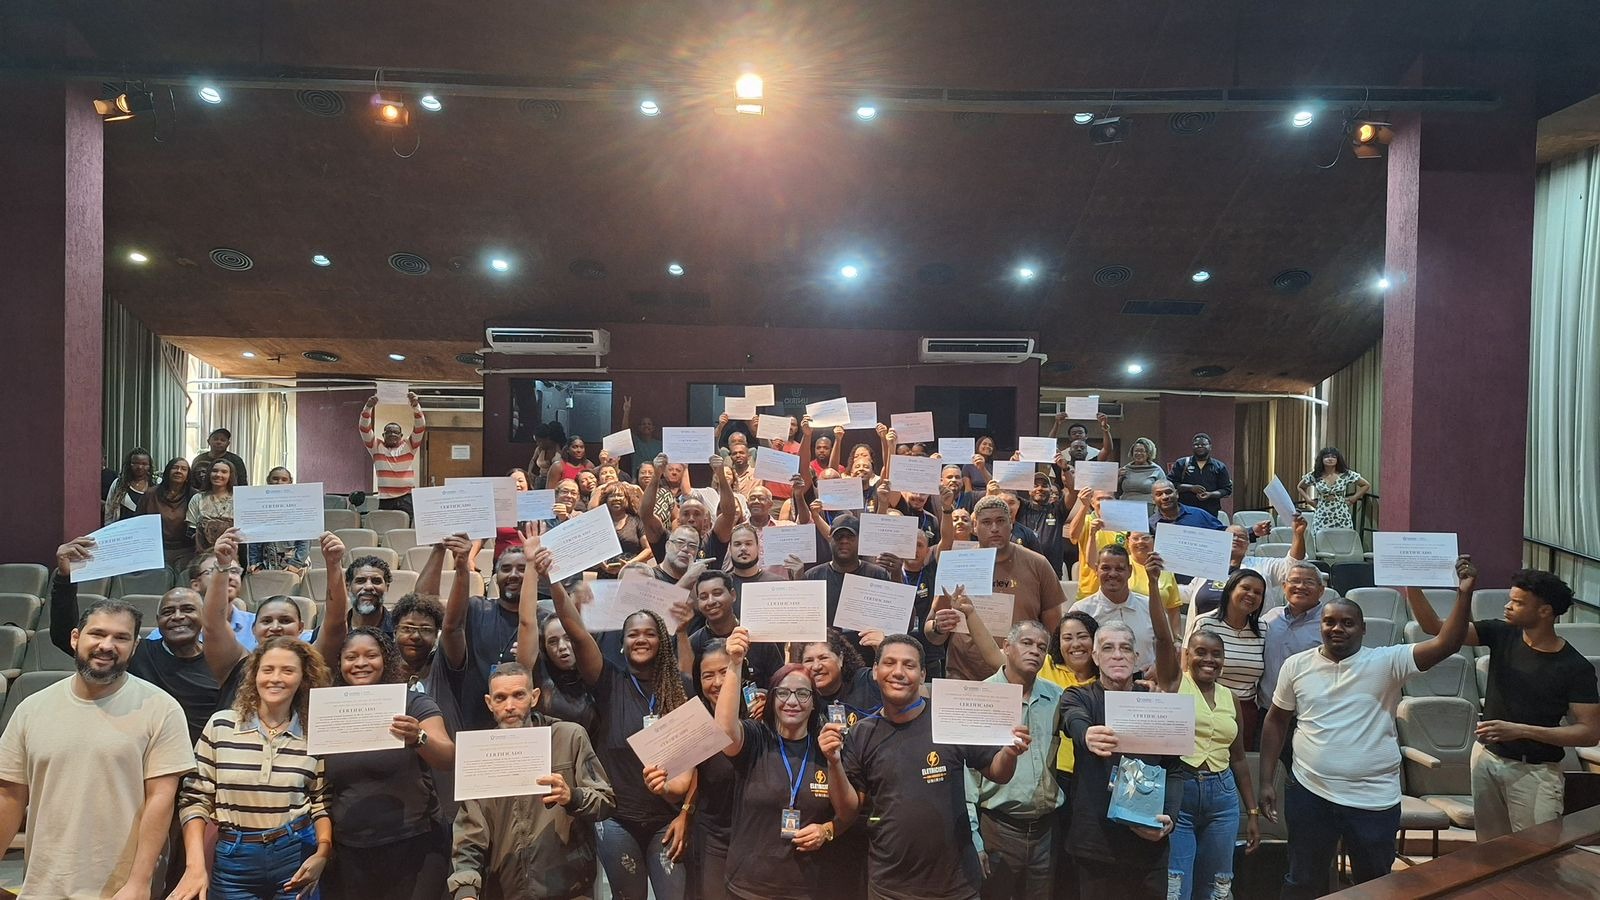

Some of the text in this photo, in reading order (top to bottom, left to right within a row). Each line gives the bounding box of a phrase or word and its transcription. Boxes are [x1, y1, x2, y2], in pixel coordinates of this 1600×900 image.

[562, 530, 592, 544] CERTIFICADO
[1178, 540, 1208, 548] CERTIFICADO
[863, 596, 893, 604] CERTIFICADO
[659, 728, 689, 747] CERTIFICADO
